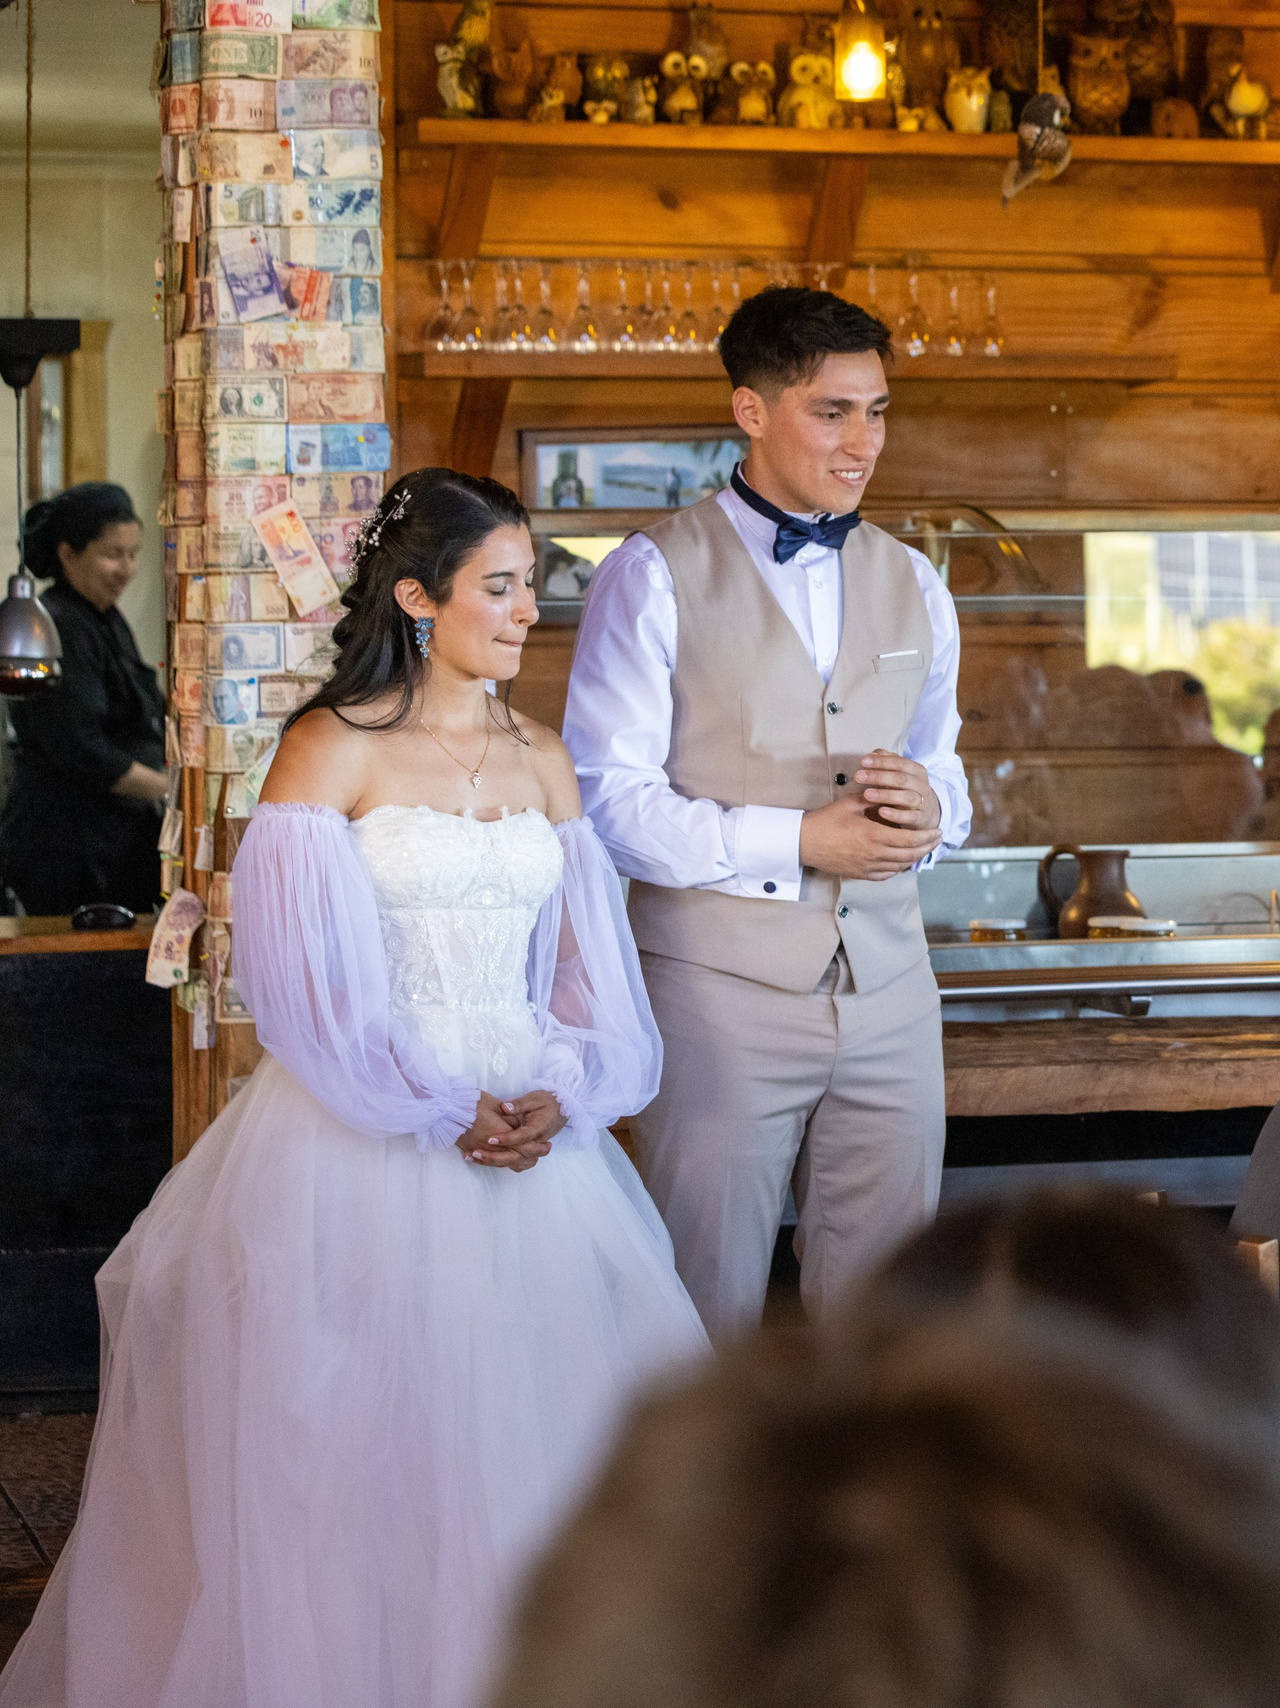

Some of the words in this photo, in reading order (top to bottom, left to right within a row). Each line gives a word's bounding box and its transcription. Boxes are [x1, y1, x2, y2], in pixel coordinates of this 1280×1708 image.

[255, 12, 273, 28] 20
[250, 107, 263, 119] 10
[369, 153, 379, 170] 5
[223, 184, 233, 199] 5
[364, 451, 387, 467] 100
